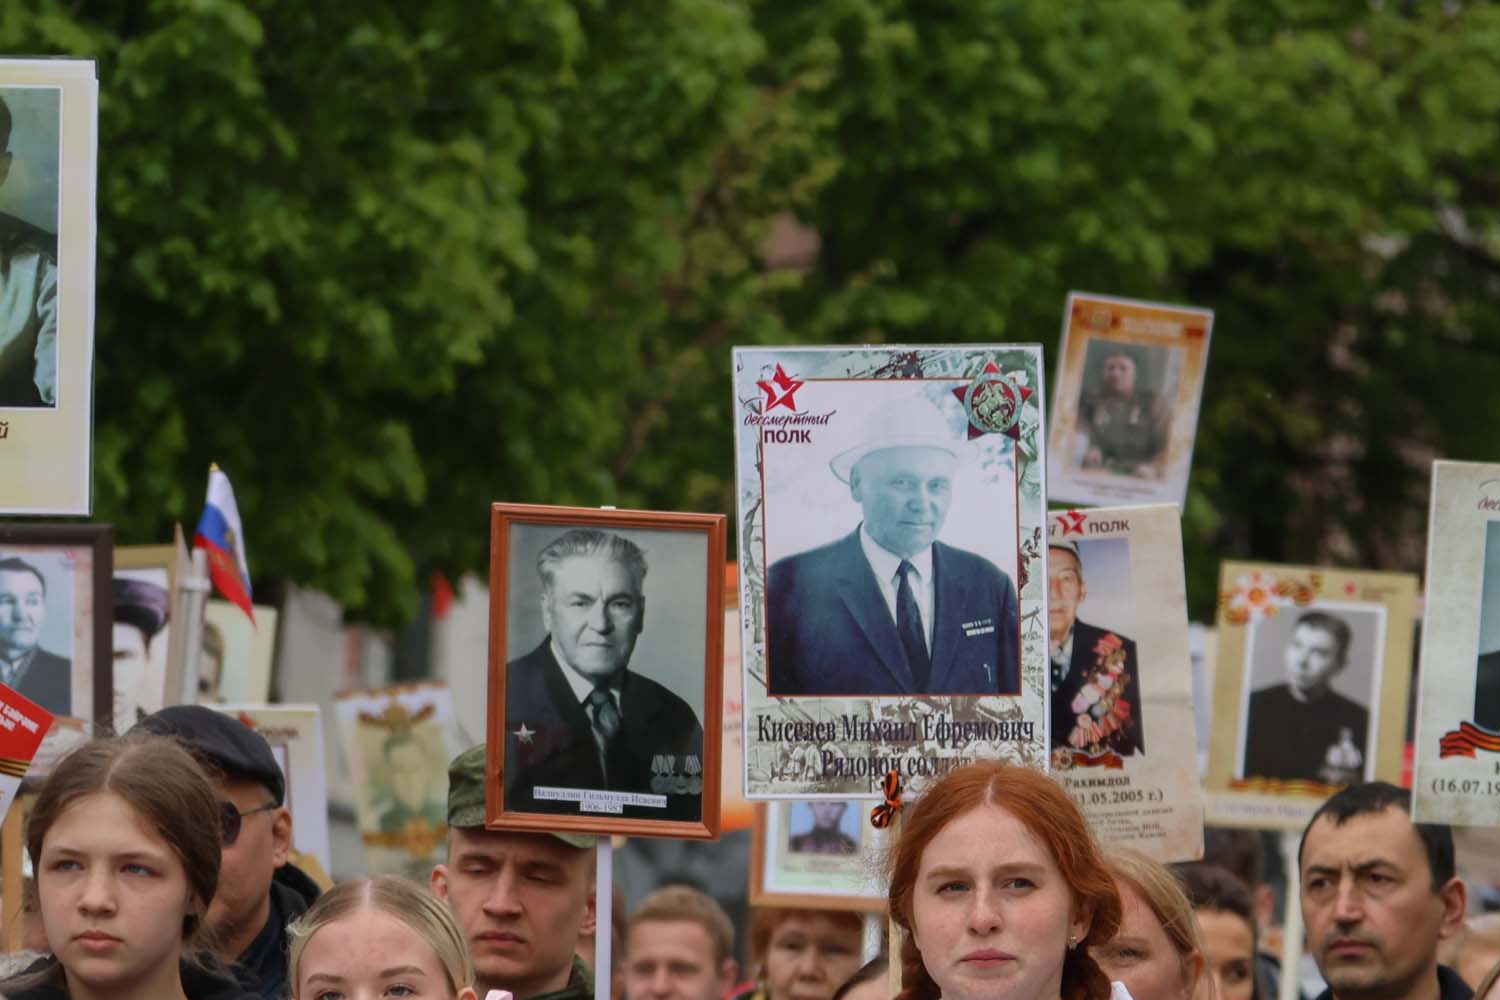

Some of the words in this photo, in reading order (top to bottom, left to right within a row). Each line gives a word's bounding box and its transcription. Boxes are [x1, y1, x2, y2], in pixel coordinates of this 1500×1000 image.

[757, 714, 836, 743] Киселев
[842, 714, 918, 743] Михаил
[923, 714, 1035, 749] Ефремович
